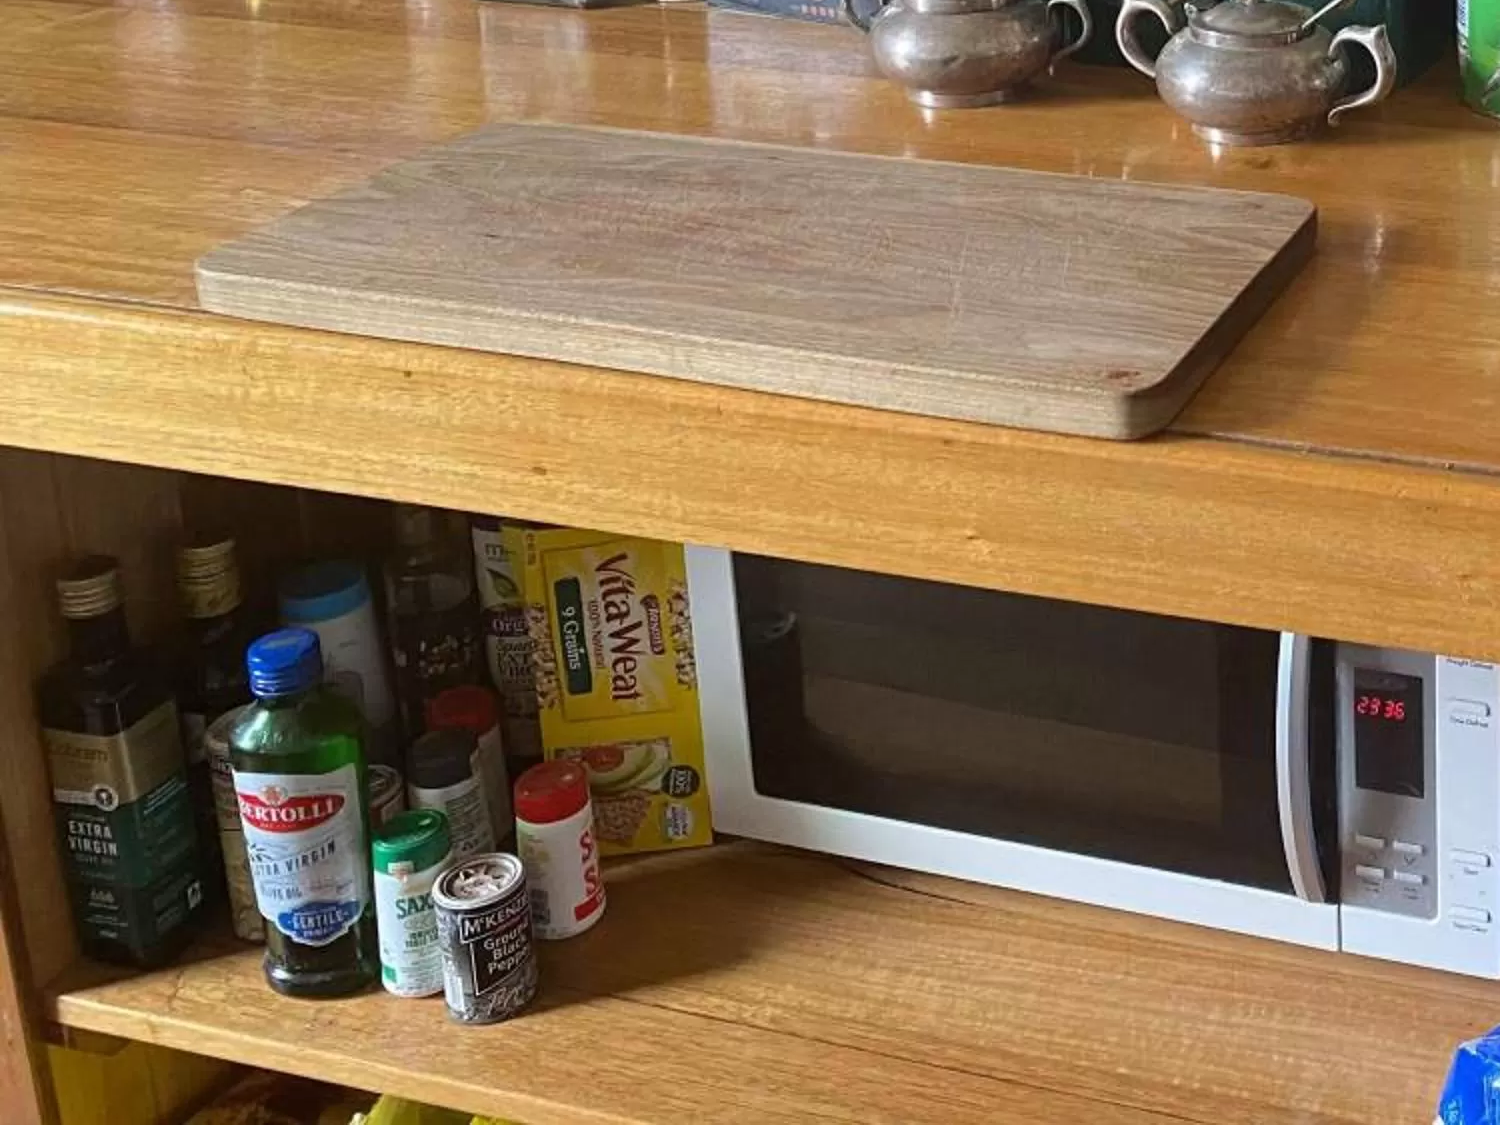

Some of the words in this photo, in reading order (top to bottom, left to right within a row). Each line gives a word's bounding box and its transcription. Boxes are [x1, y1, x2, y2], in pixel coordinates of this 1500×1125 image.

[563, 620, 585, 671] Grains
[68, 820, 113, 839] EXTRA
[67, 836, 118, 856] VIRGIN
[285, 838, 336, 872] VIRGIN
[395, 893, 435, 920] SAX
